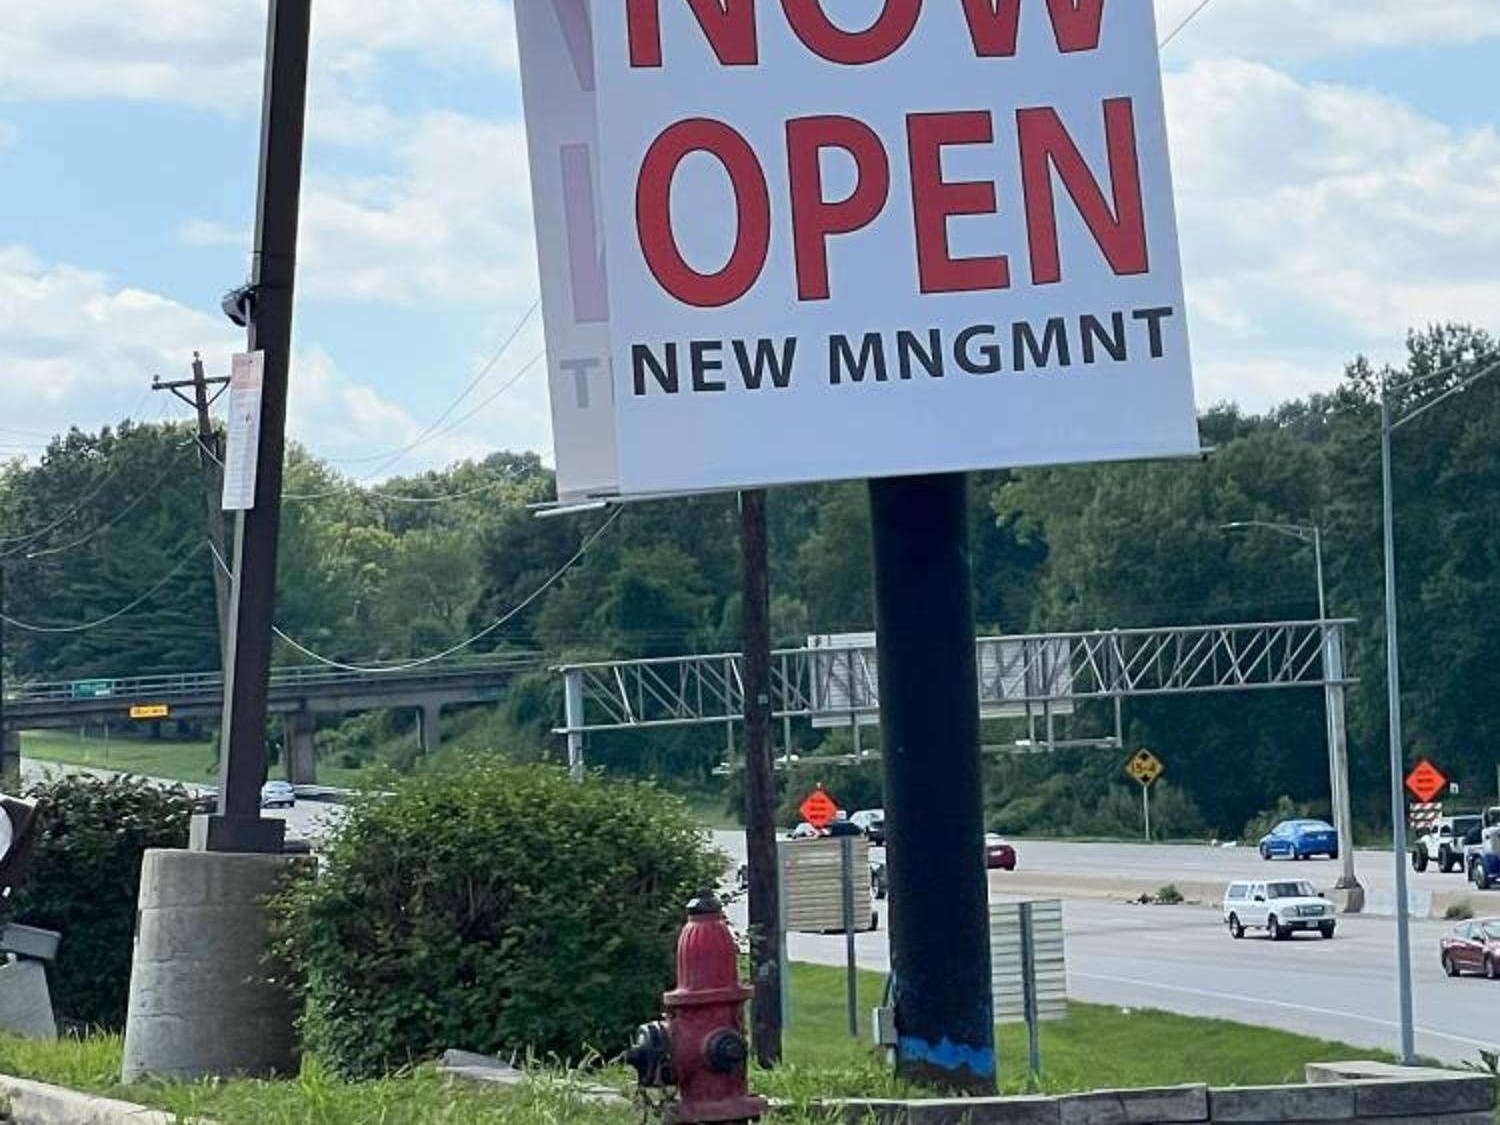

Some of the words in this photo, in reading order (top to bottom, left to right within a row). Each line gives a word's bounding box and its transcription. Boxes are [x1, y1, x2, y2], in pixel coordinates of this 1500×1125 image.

[635, 96, 1149, 308] OPEN
[631, 335, 798, 396] NEW
[828, 306, 1174, 388] MNGMNT
